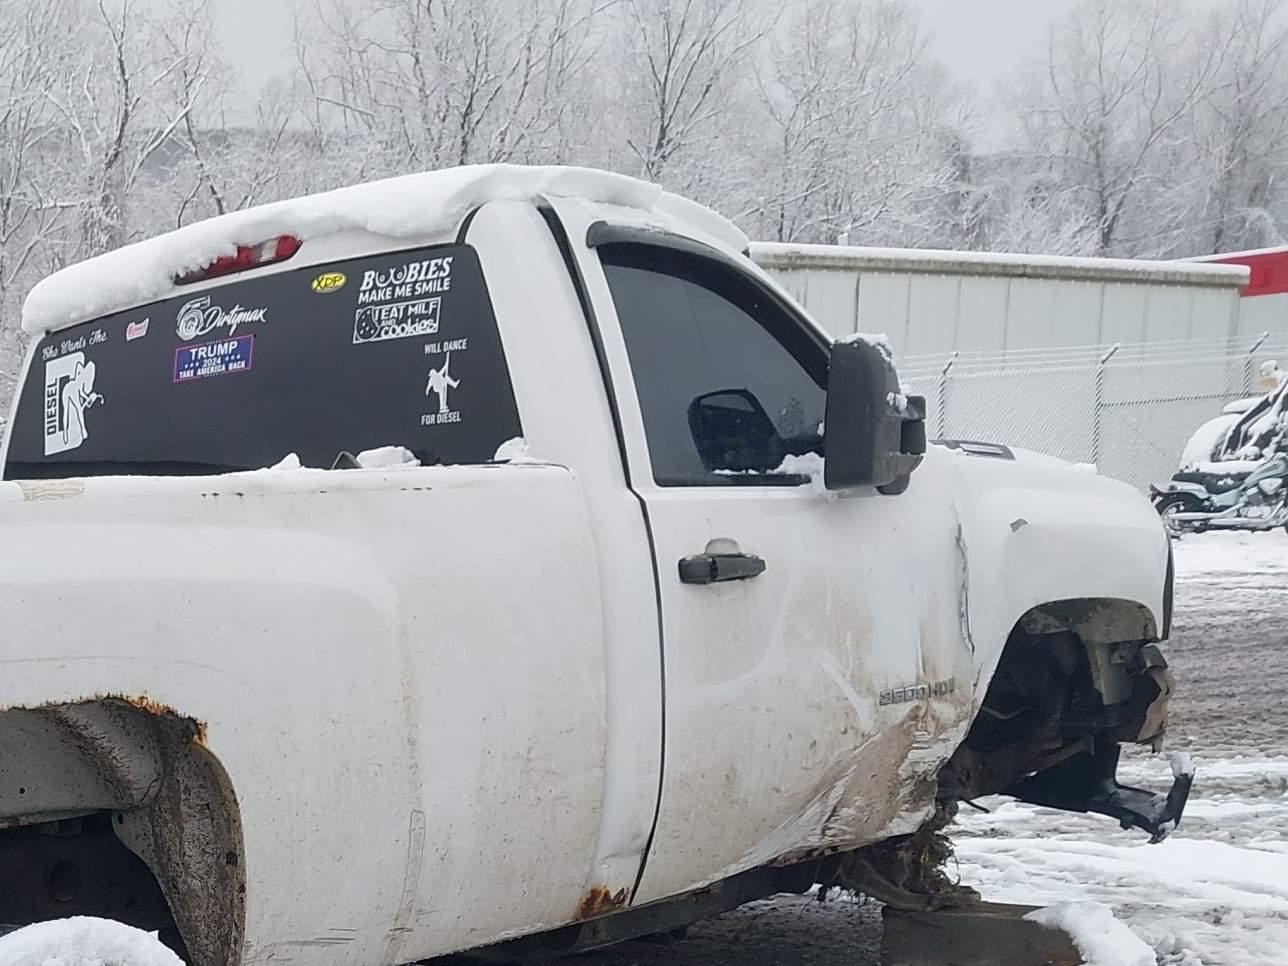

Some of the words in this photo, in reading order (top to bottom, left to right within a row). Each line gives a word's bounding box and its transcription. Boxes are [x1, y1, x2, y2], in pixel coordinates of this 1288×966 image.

[314, 276, 343, 290] XDP
[358, 286, 393, 305] MAKE
[394, 283, 413, 299] ME
[414, 277, 451, 296] SMILE
[196, 304, 268, 337] Dirtymax
[380, 305, 406, 321] EAT
[407, 301, 438, 317] MILF
[42, 345, 59, 361] She
[61, 336, 86, 355] Wants
[88, 329, 108, 346] The
[189, 340, 239, 361] TRUMP
[424, 342, 442, 355] WILL
[443, 338, 468, 352] DANCE
[179, 369, 195, 379] TAKE
[196, 363, 226, 376] AMERICA
[228, 360, 246, 371] BACK
[202, 356, 222, 368] 2024
[46, 377, 58, 436] DIESEL
[420, 414, 436, 426] FOR
[436, 411, 462, 424] DIESEL
